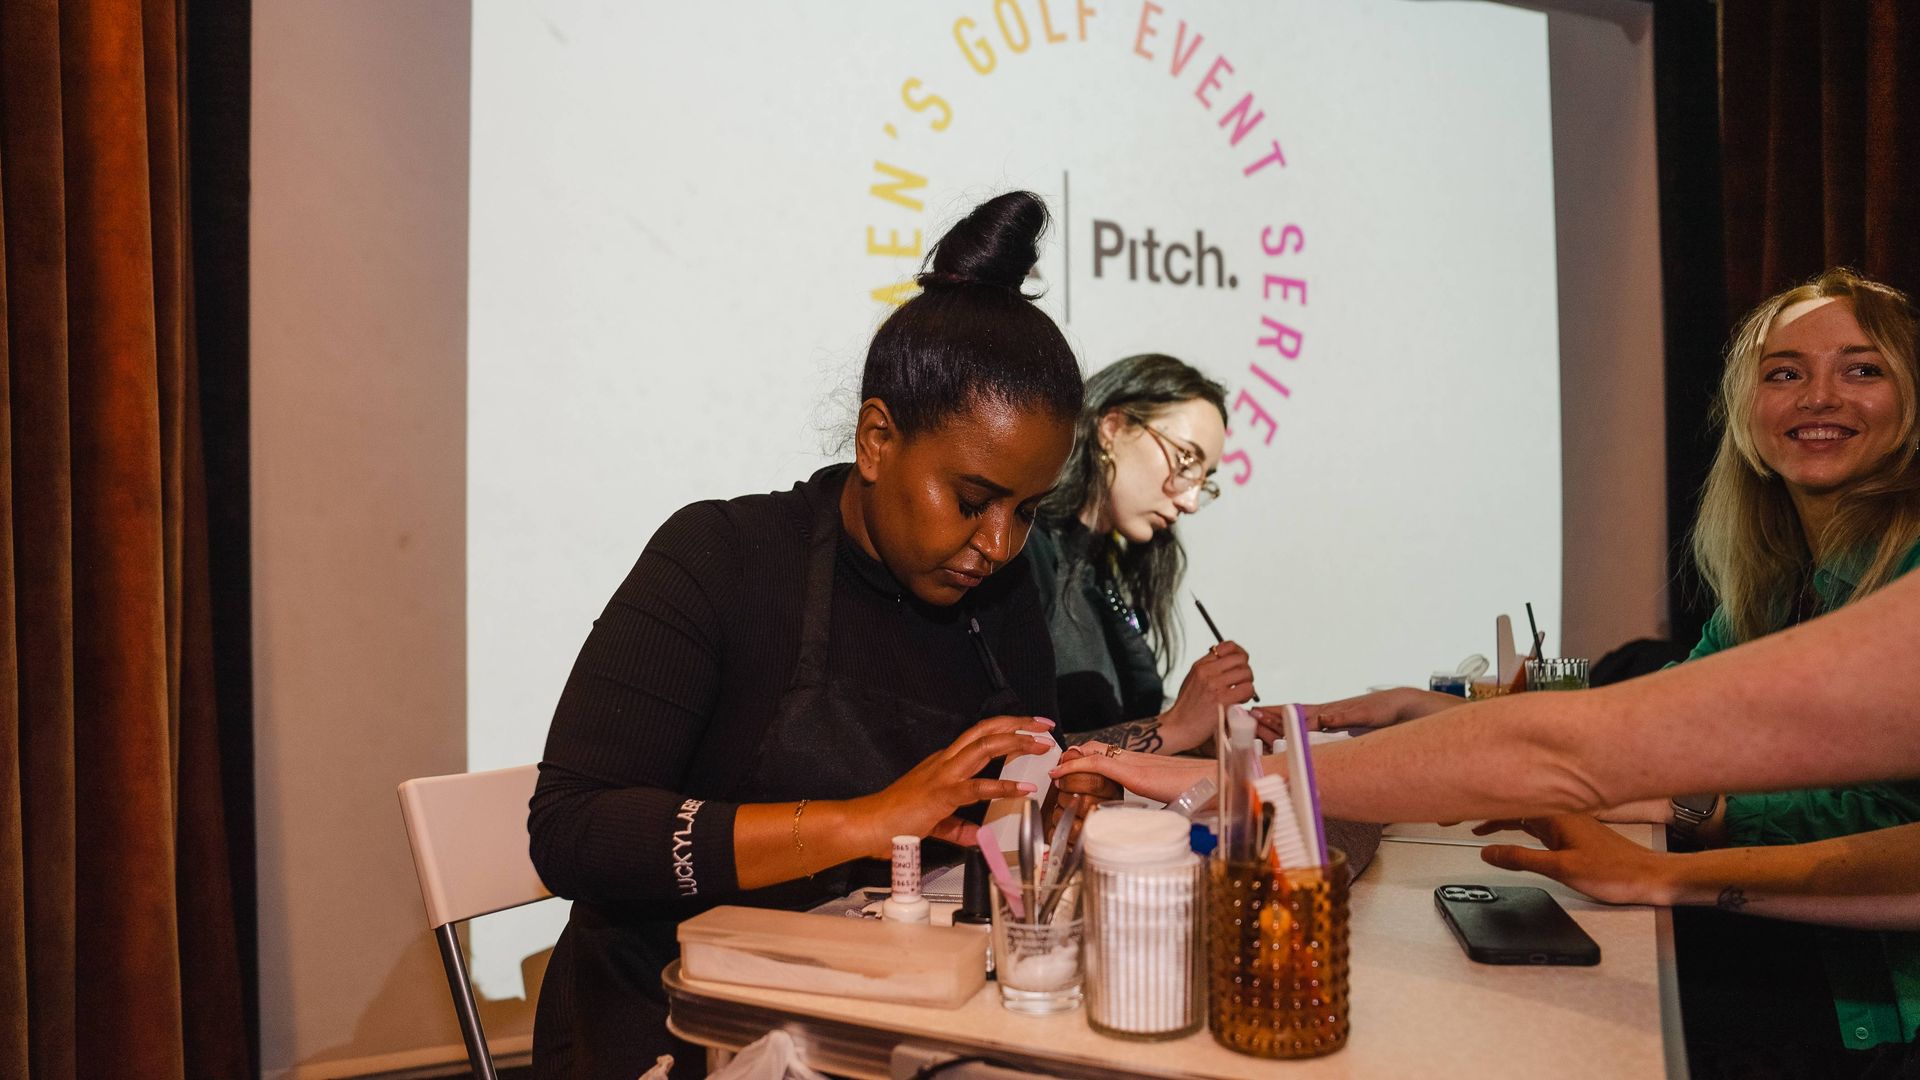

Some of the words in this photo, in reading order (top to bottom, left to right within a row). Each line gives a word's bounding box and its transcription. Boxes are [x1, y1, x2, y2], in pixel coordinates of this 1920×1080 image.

[952, 0, 1096, 76] GOLF
[1132, 1, 1287, 177] EVENT
[1222, 224, 1308, 486] SERIES
